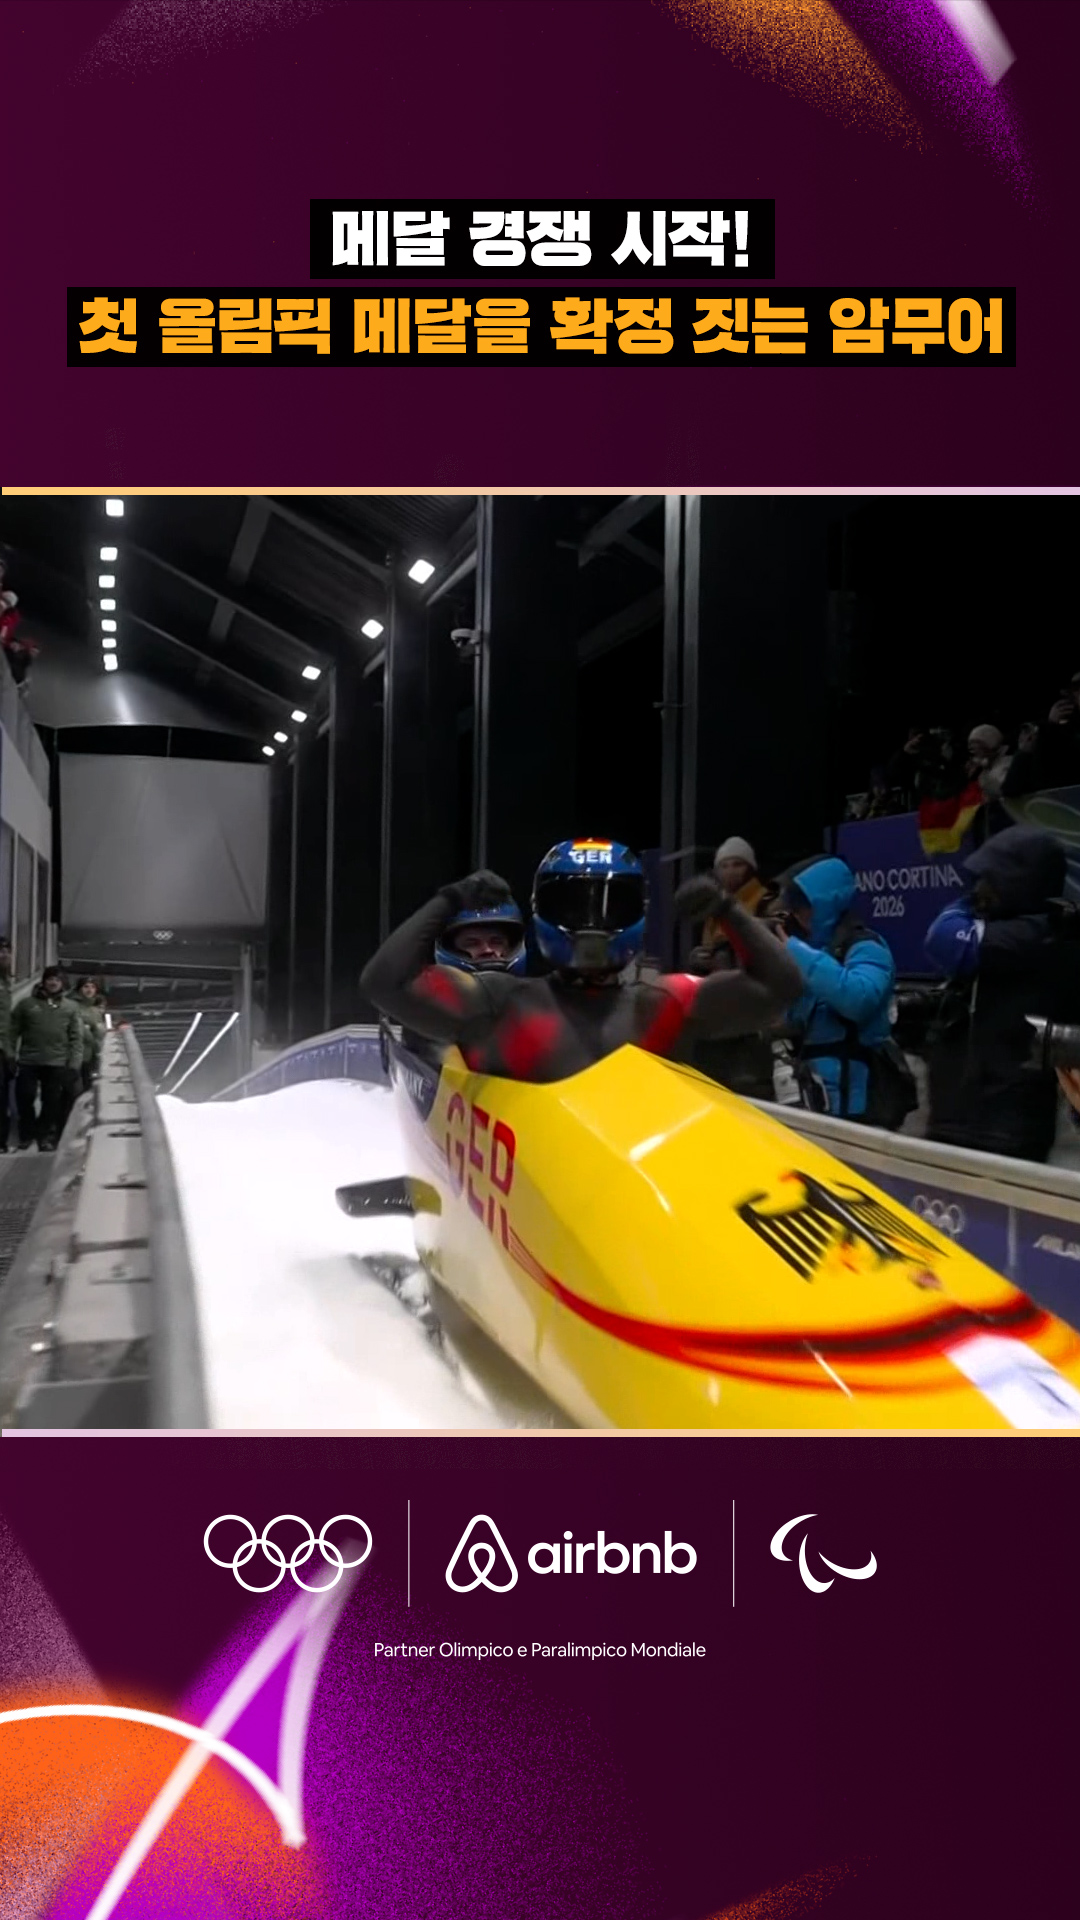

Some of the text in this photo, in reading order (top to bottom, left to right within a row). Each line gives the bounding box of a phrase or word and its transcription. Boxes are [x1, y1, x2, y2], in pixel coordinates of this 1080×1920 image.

[572, 850, 613, 864] GER
[854, 864, 964, 892] ANO CORTINA
[872, 895, 906, 917] 2026
[446, 1092, 516, 1250] GER
